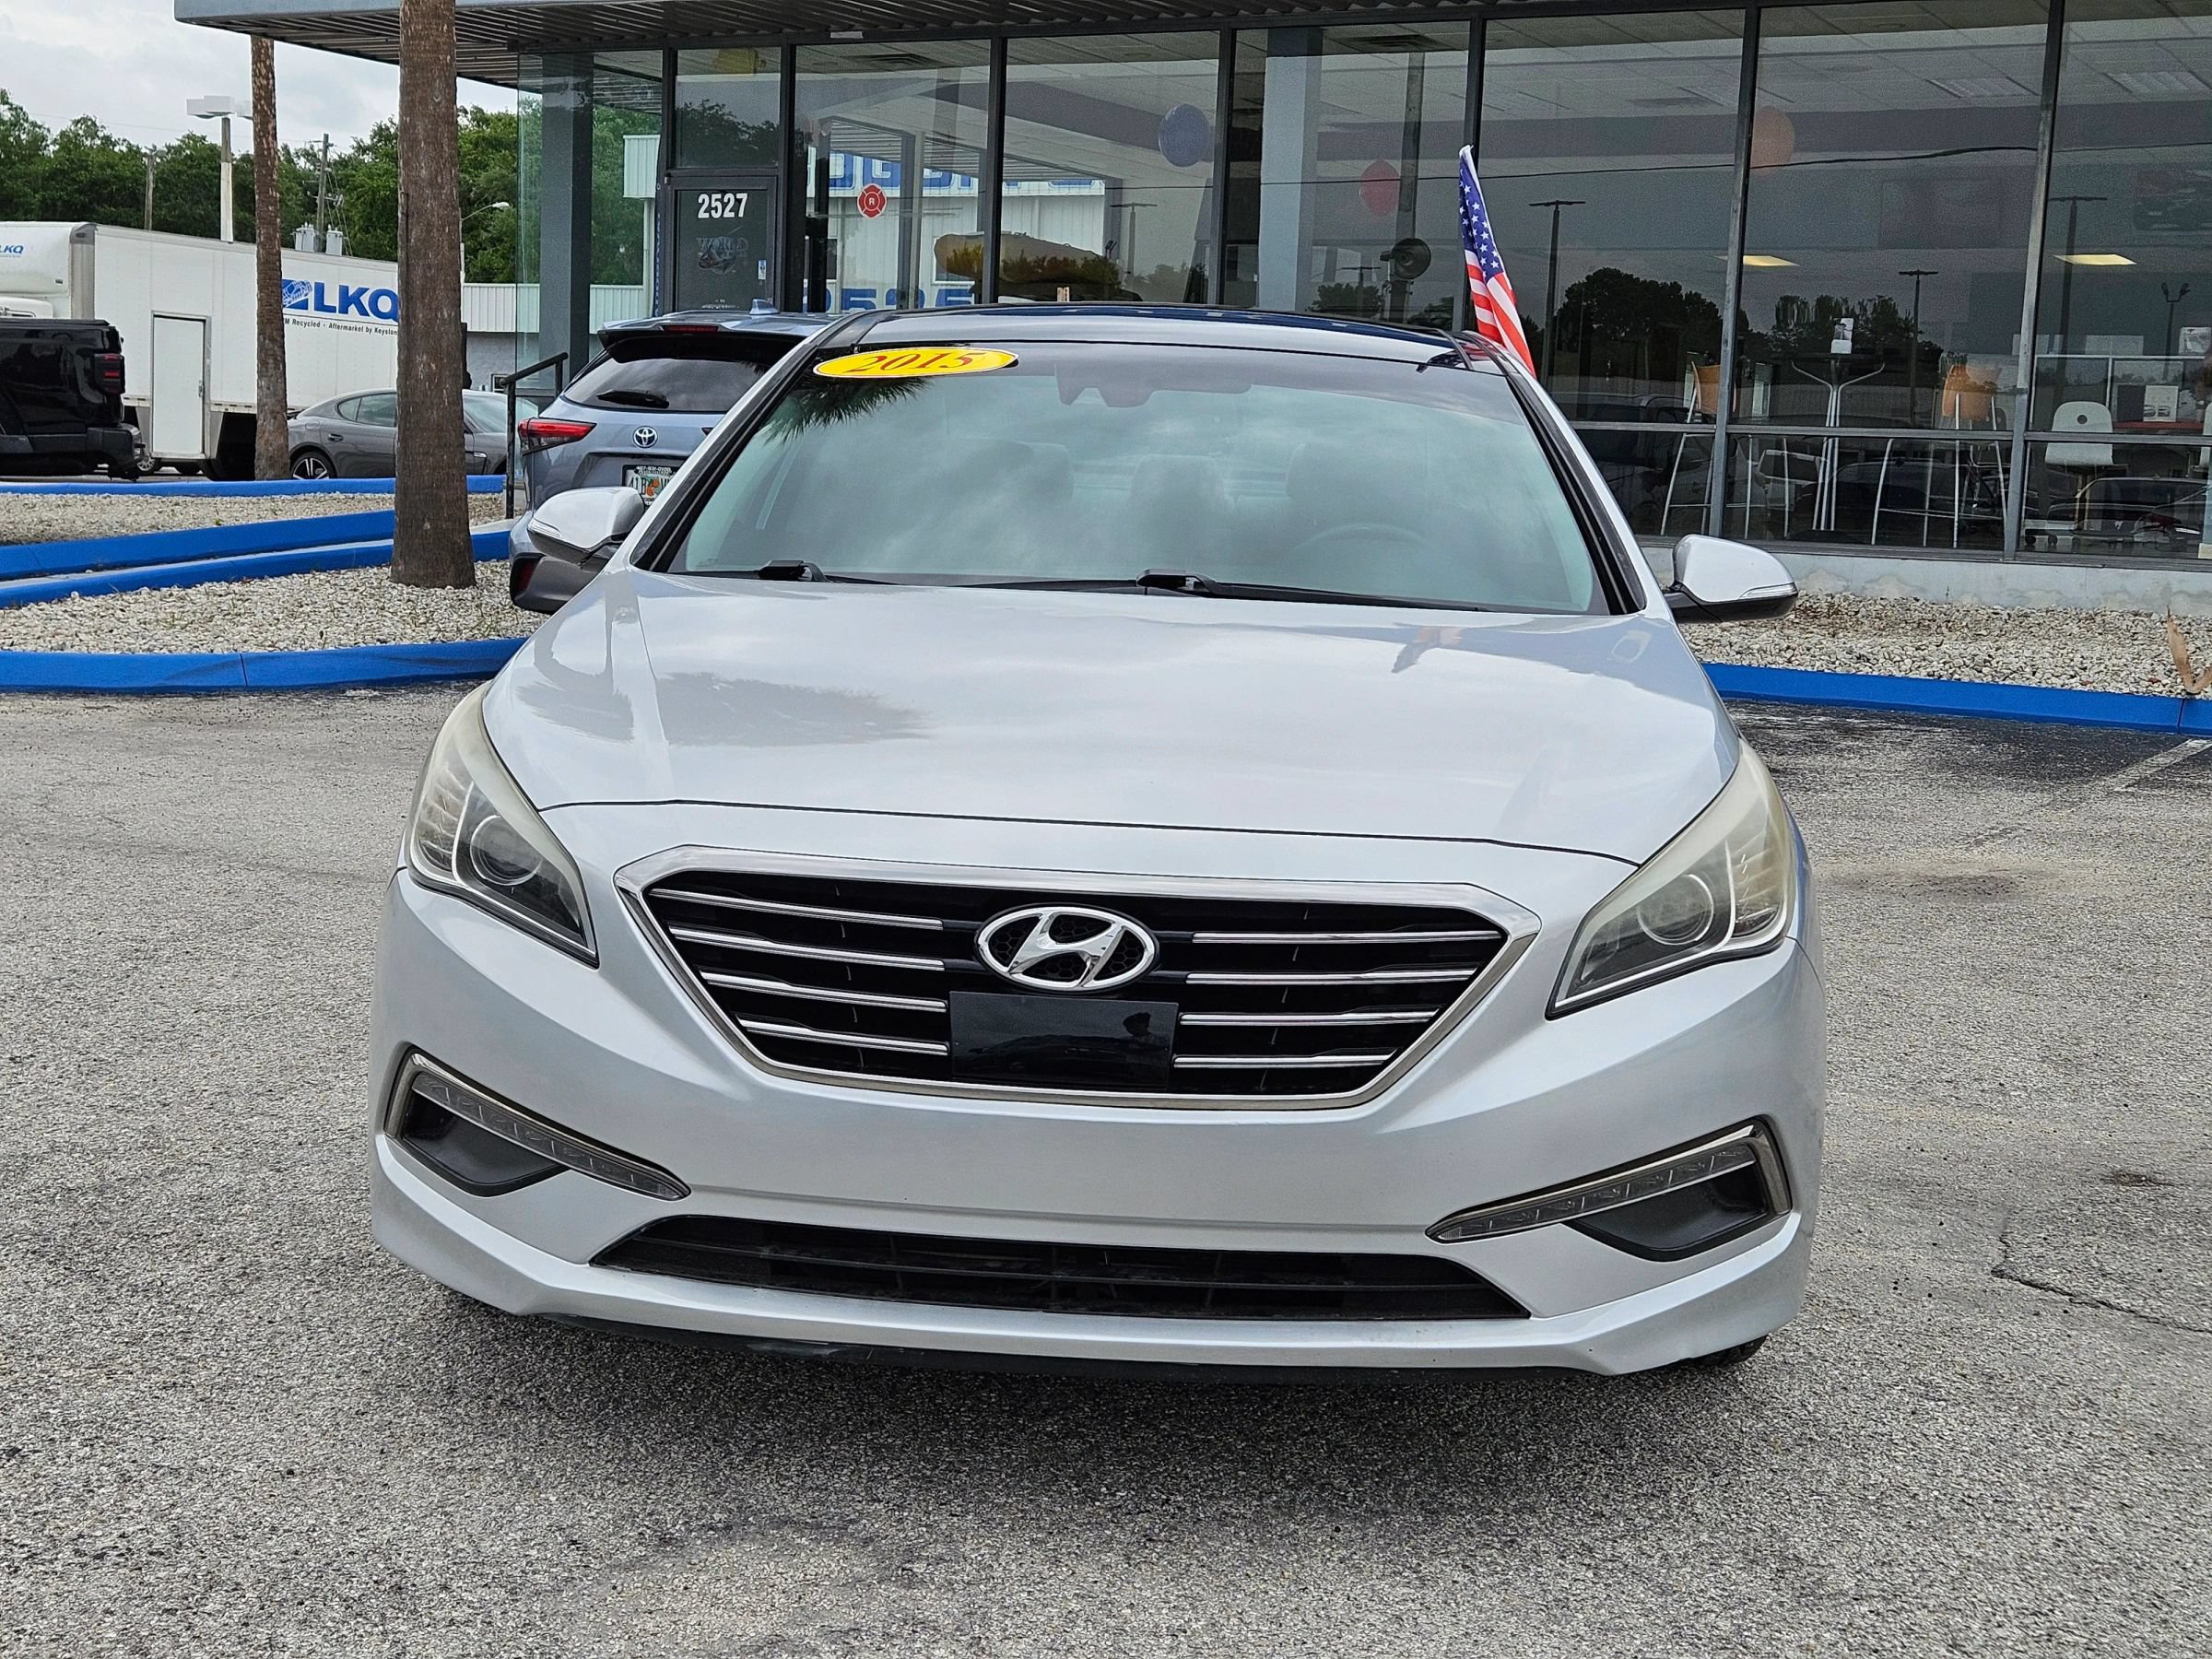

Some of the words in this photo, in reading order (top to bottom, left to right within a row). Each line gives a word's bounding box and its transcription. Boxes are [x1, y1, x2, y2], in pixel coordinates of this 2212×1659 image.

[698, 193, 747, 218] 2527
[868, 197, 876, 206] R
[696, 236, 749, 252] WORD
[313, 281, 398, 323] LKQ
[292, 319, 321, 328] Recycled
[328, 323, 364, 333] Aftermarket
[366, 324, 372, 335] by
[845, 352, 986, 373] 2015
